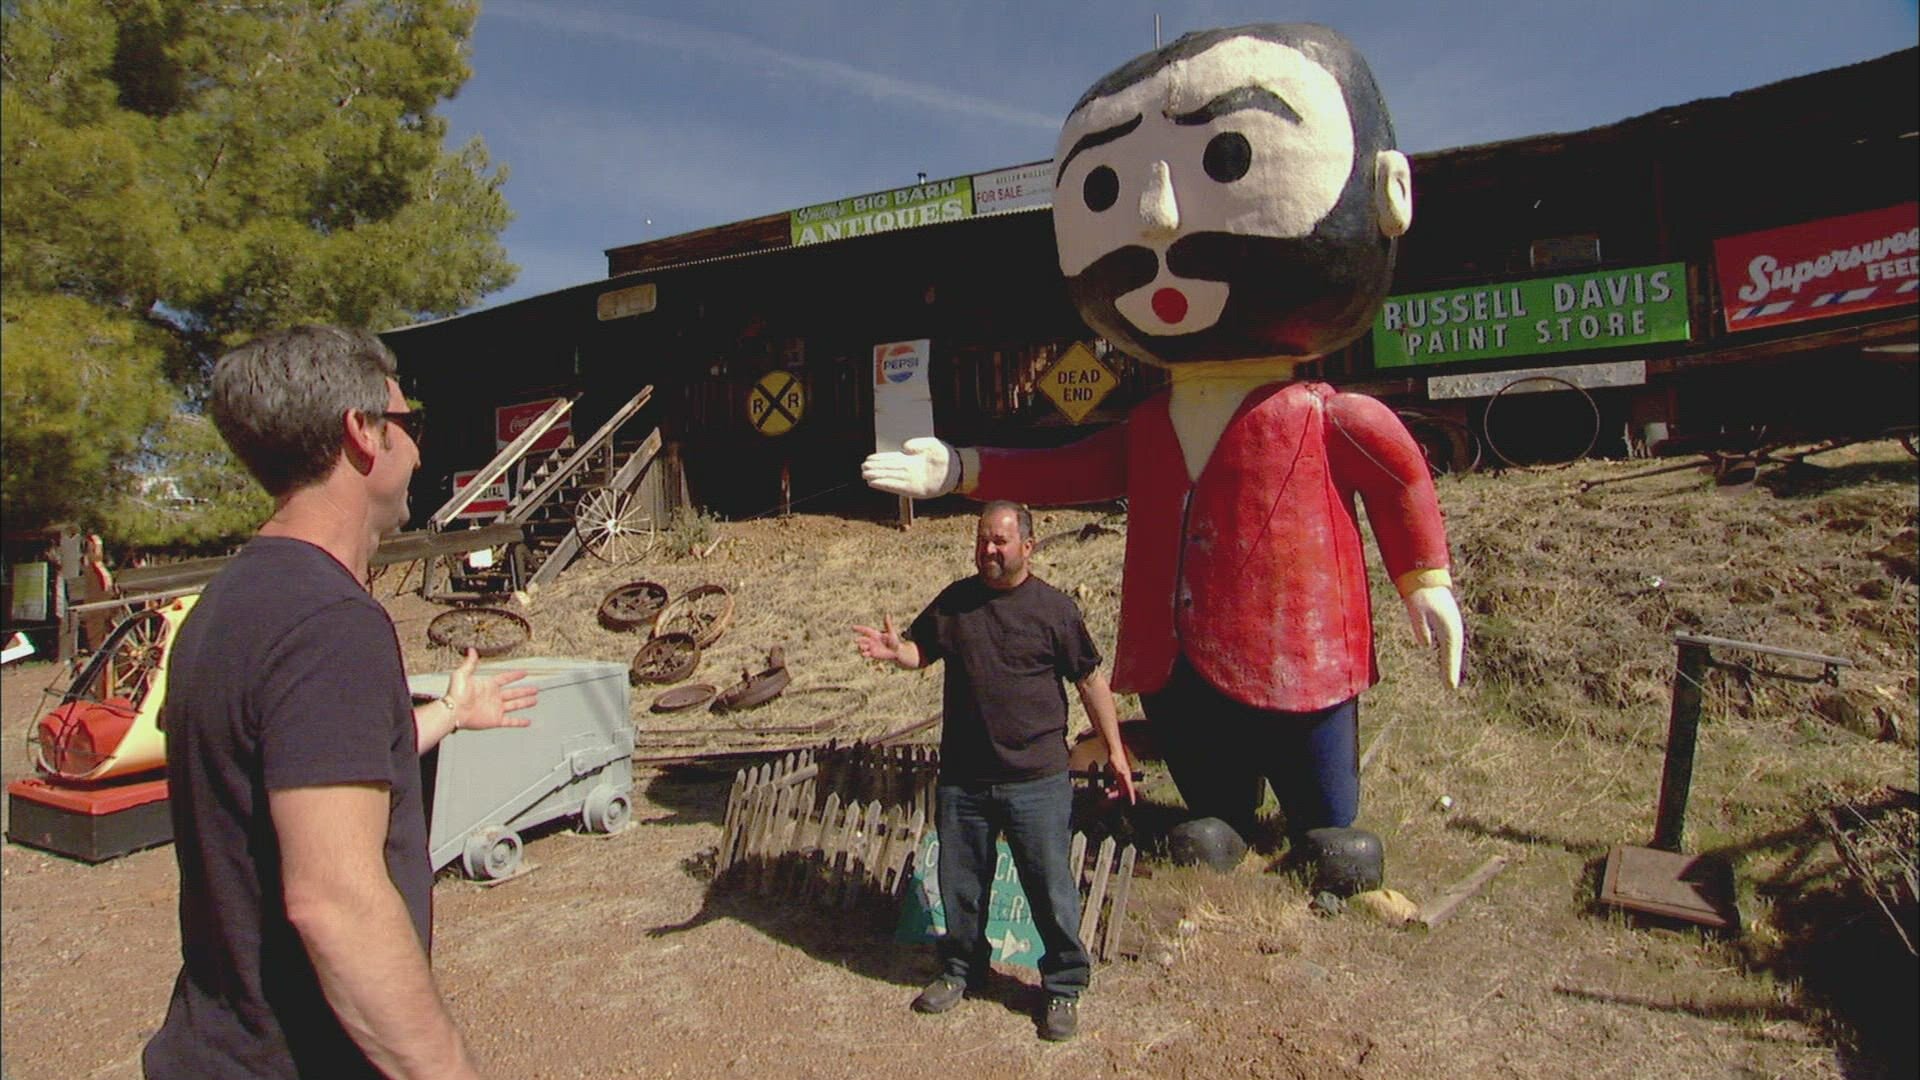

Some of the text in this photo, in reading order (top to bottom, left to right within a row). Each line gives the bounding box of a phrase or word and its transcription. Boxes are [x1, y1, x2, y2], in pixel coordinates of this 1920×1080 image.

[853, 193, 888, 213] BIG
[895, 180, 956, 205] BARN
[976, 185, 1024, 203] FOR SALE
[800, 198, 963, 245] ANTIQUES
[1384, 271, 1672, 331] RUSSELL DAVIS
[1408, 309, 1647, 356] PAINT STORE
[883, 357, 919, 370] PEPSI
[1057, 369, 1101, 385] DEAD
[752, 392, 799, 414] R R
[1063, 387, 1093, 401] END
